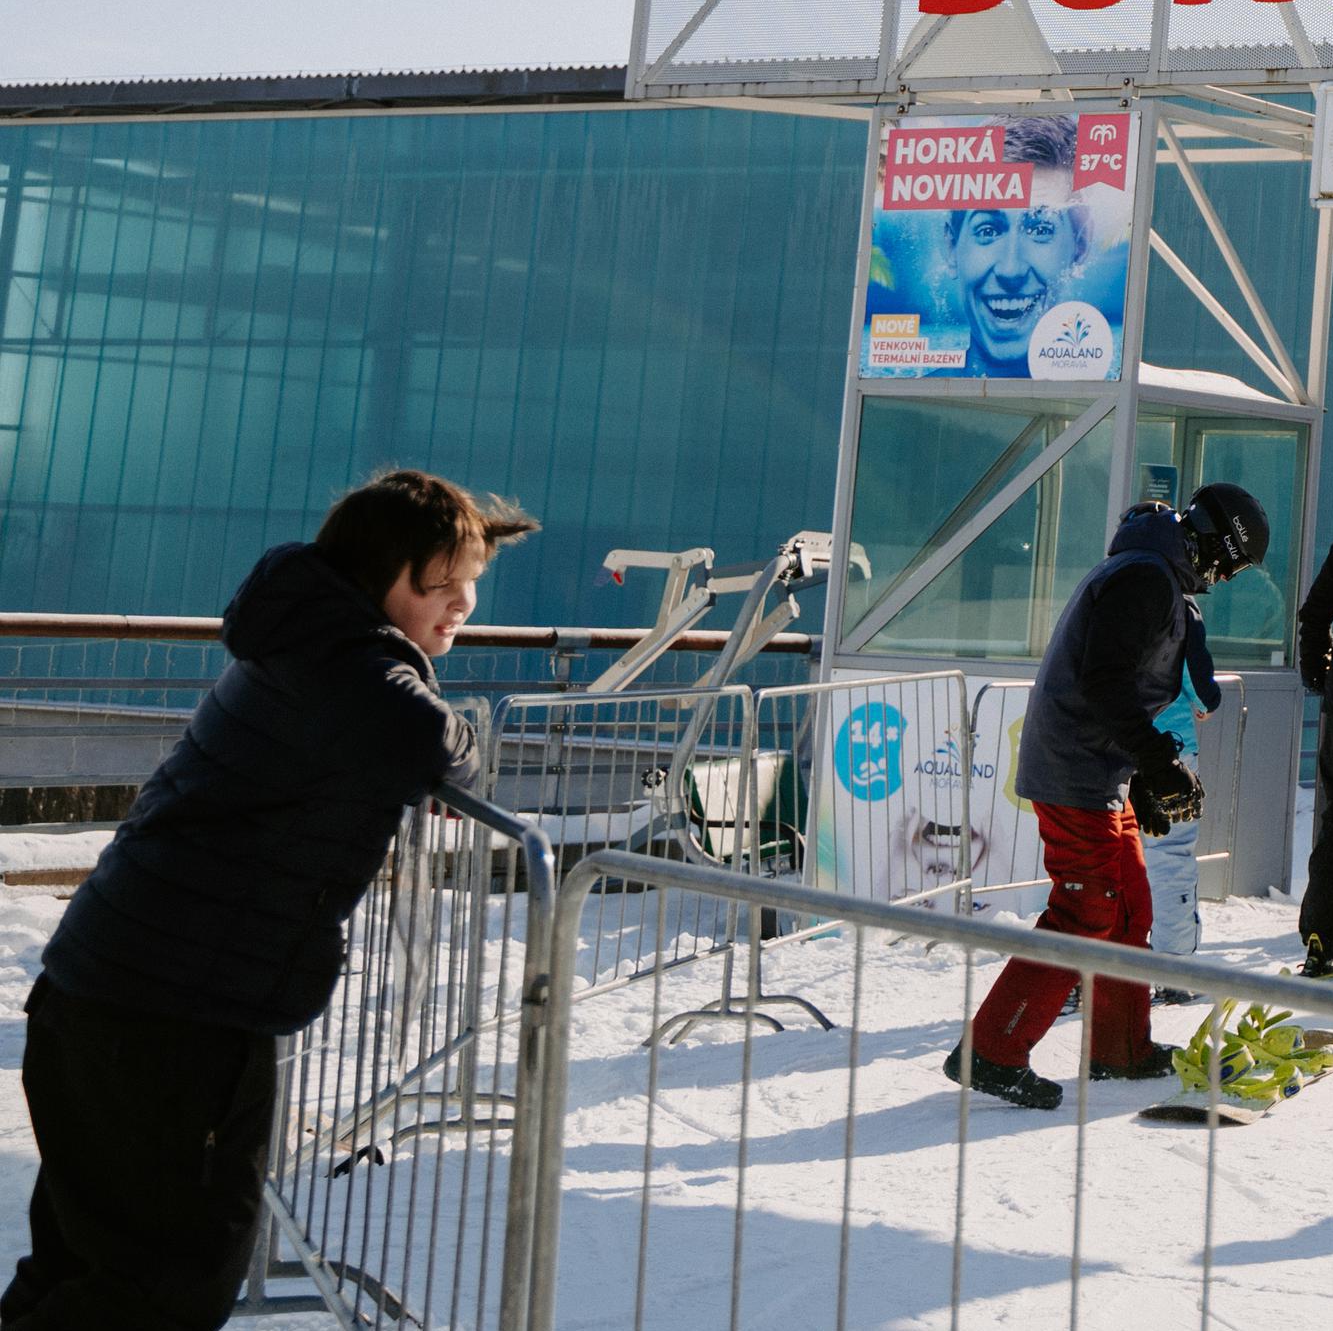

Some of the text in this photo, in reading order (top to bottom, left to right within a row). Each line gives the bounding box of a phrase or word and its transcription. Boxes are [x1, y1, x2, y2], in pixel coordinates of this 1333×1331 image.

[894, 130, 996, 164] HORKÁ
[1080, 154, 1100, 170] 37
[891, 173, 1025, 202] NOVINKA
[875, 317, 915, 334] NOVÉ
[873, 339, 926, 351] VENKOVNÍ
[1038, 346, 1103, 359] AQUALAND
[1052, 360, 1088, 369] MORAVIA
[914, 760, 994, 779] AQUALND
